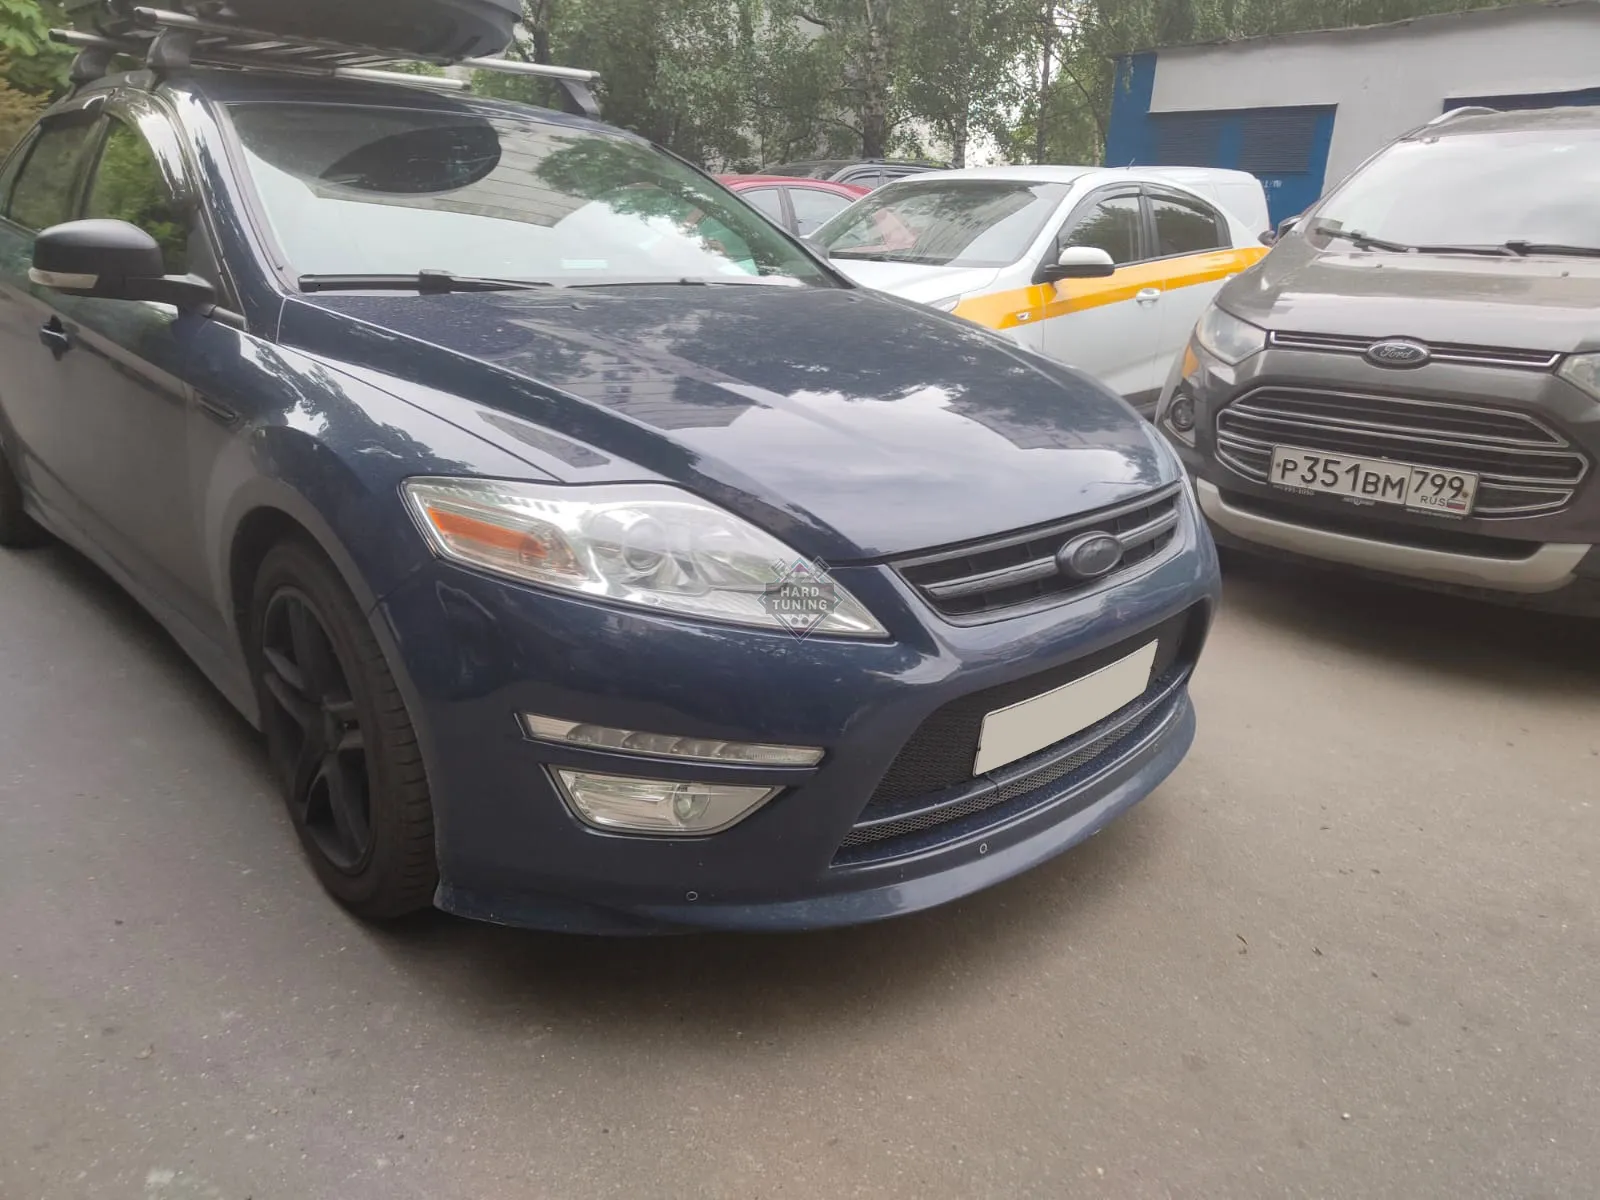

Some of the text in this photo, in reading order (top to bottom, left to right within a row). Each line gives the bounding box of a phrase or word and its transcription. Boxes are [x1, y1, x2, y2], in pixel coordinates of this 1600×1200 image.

[1380, 344, 1414, 359] Ford
[1414, 470, 1465, 499] 799
[1420, 495, 1446, 507] RUS
